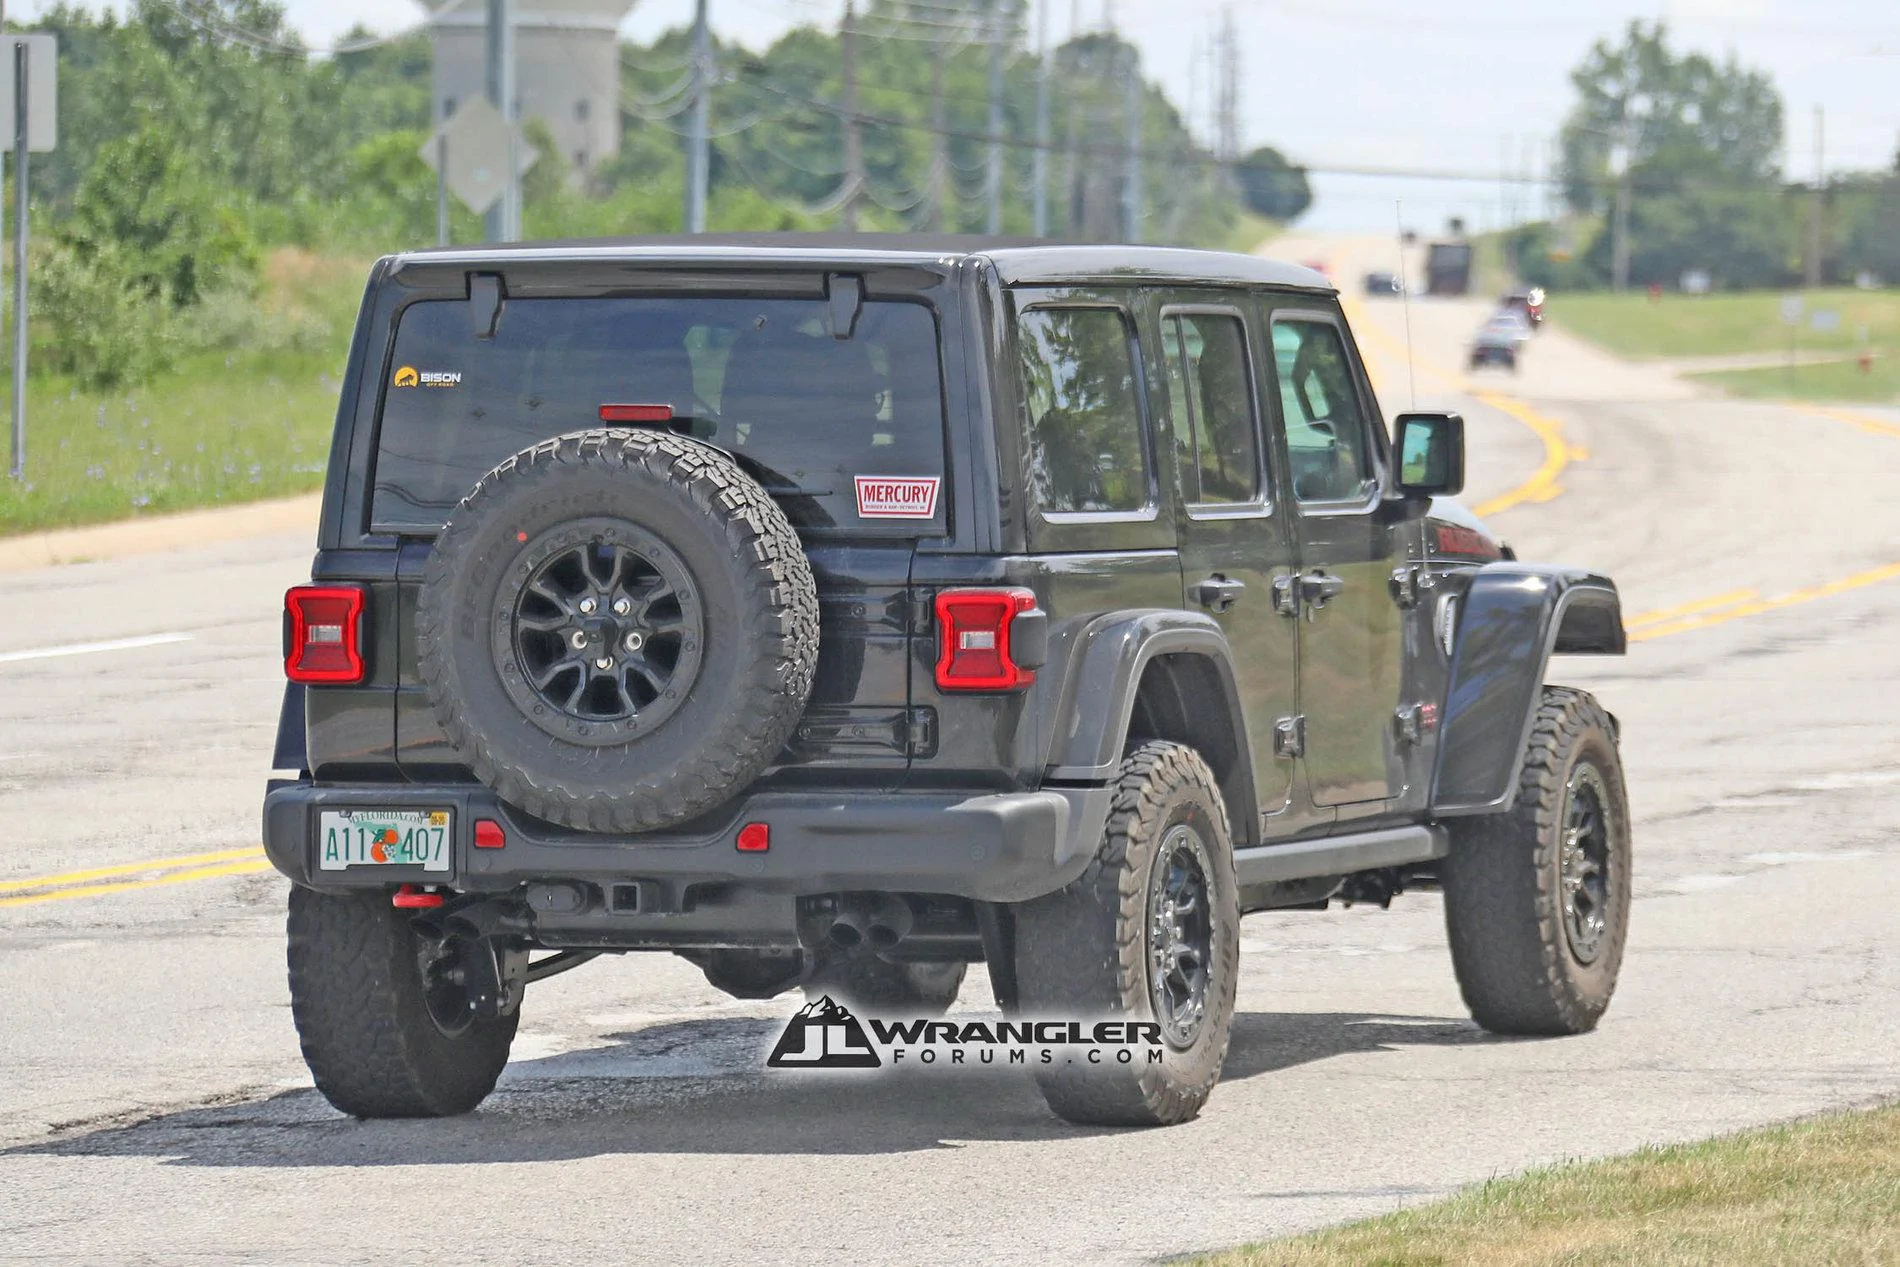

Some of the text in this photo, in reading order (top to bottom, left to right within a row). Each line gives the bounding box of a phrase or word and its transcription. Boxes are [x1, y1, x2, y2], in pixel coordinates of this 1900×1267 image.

[420, 373, 461, 383] BISON
[864, 485, 929, 503] MERCURY
[326, 827, 444, 861] A11 407
